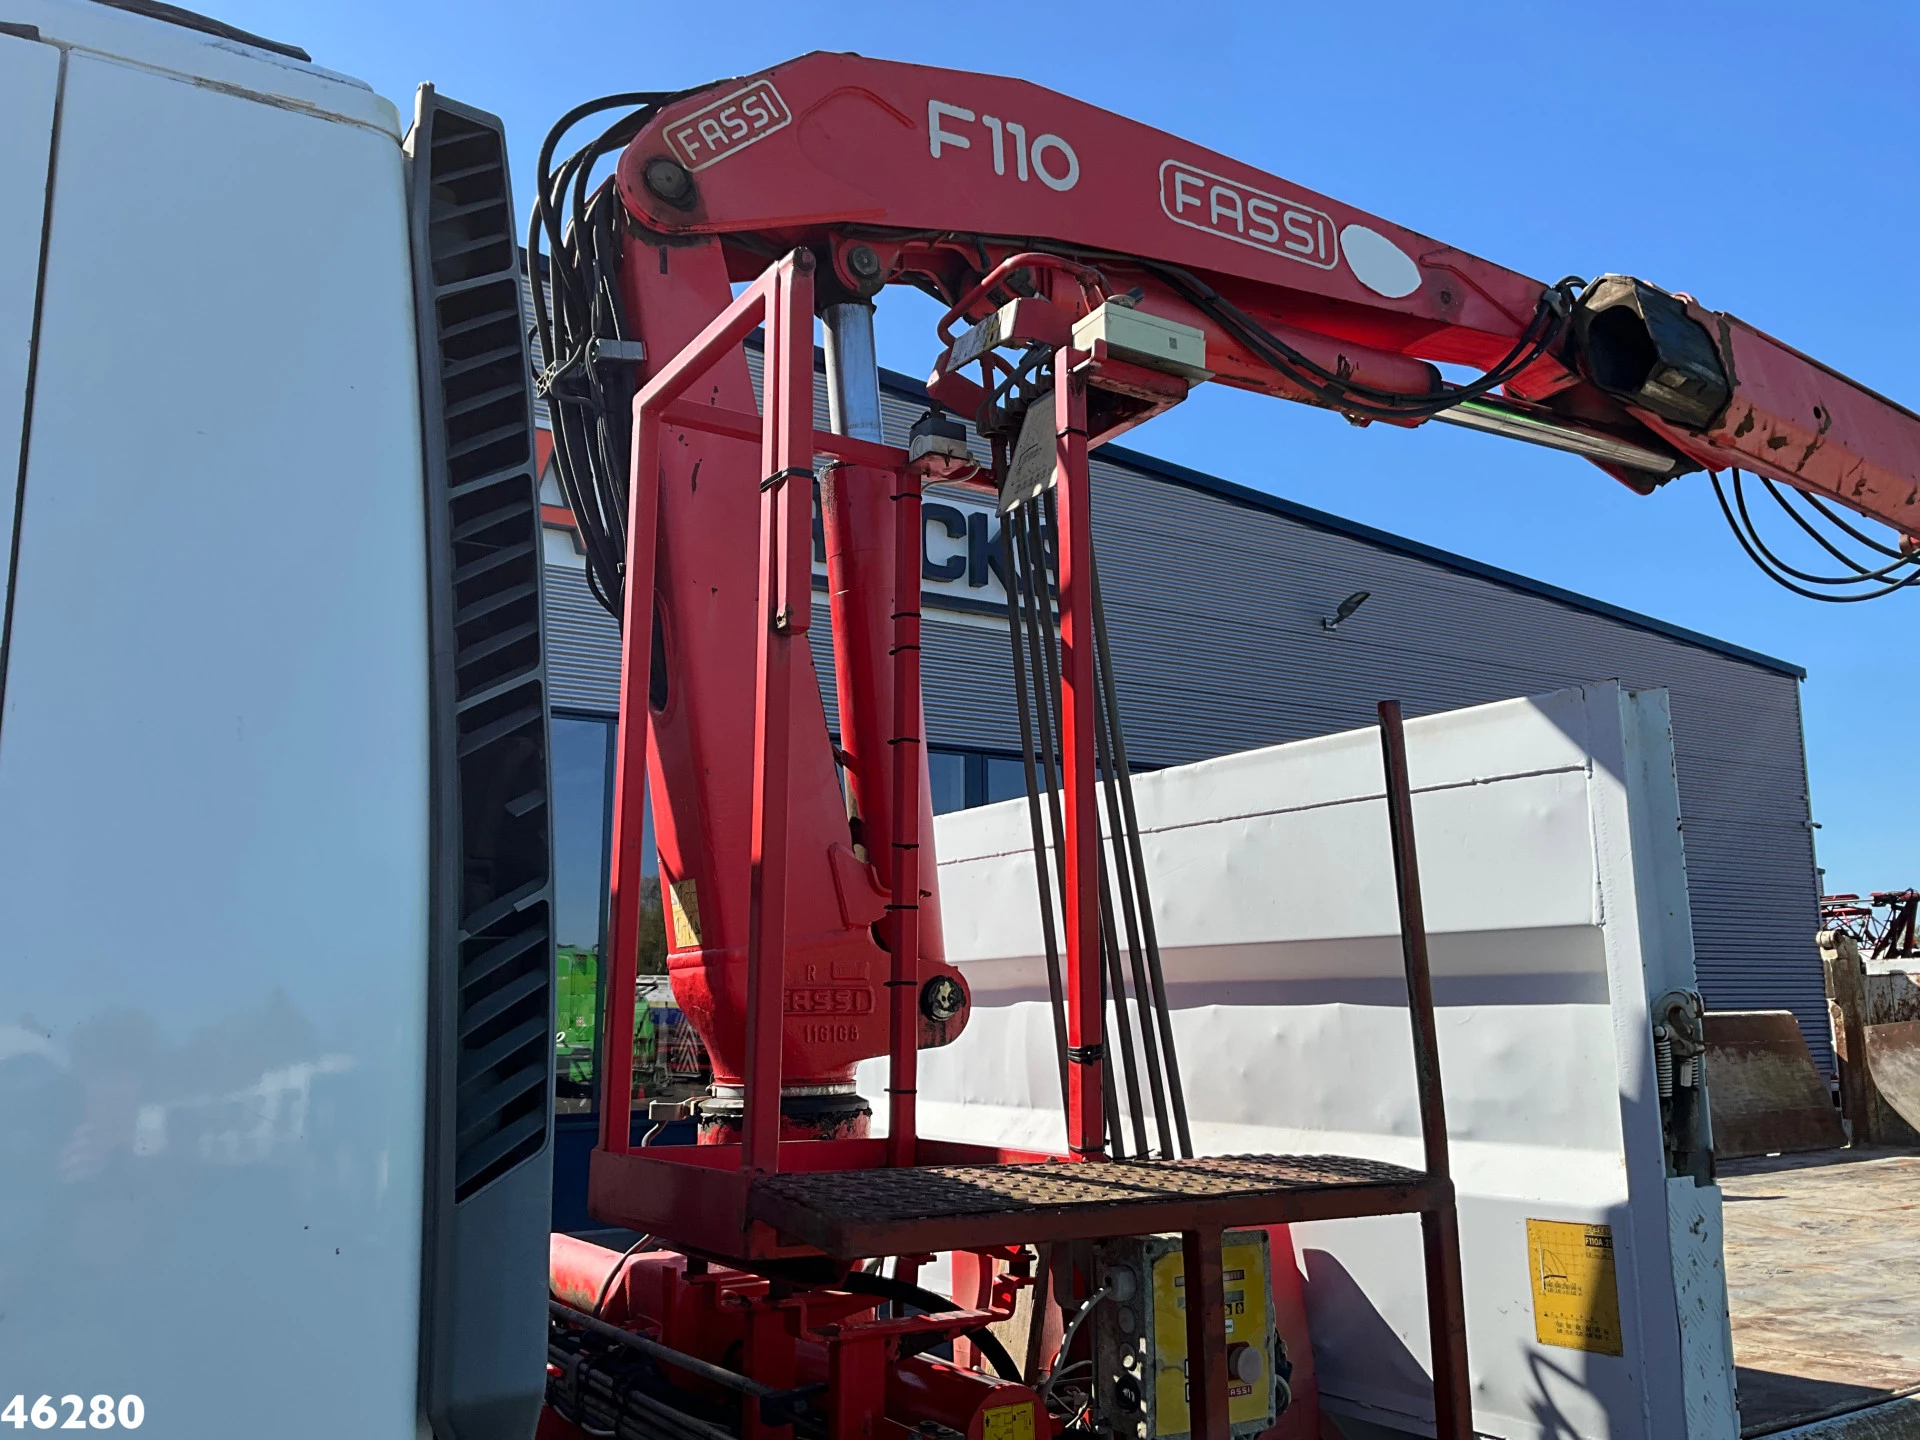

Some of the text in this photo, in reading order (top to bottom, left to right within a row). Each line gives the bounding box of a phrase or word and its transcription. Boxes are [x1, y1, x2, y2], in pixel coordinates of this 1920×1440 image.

[676, 91, 780, 161] FASSI
[928, 99, 1080, 192] F110
[1174, 171, 1326, 260] FASSI
[1229, 1386, 1250, 1396] ASSI
